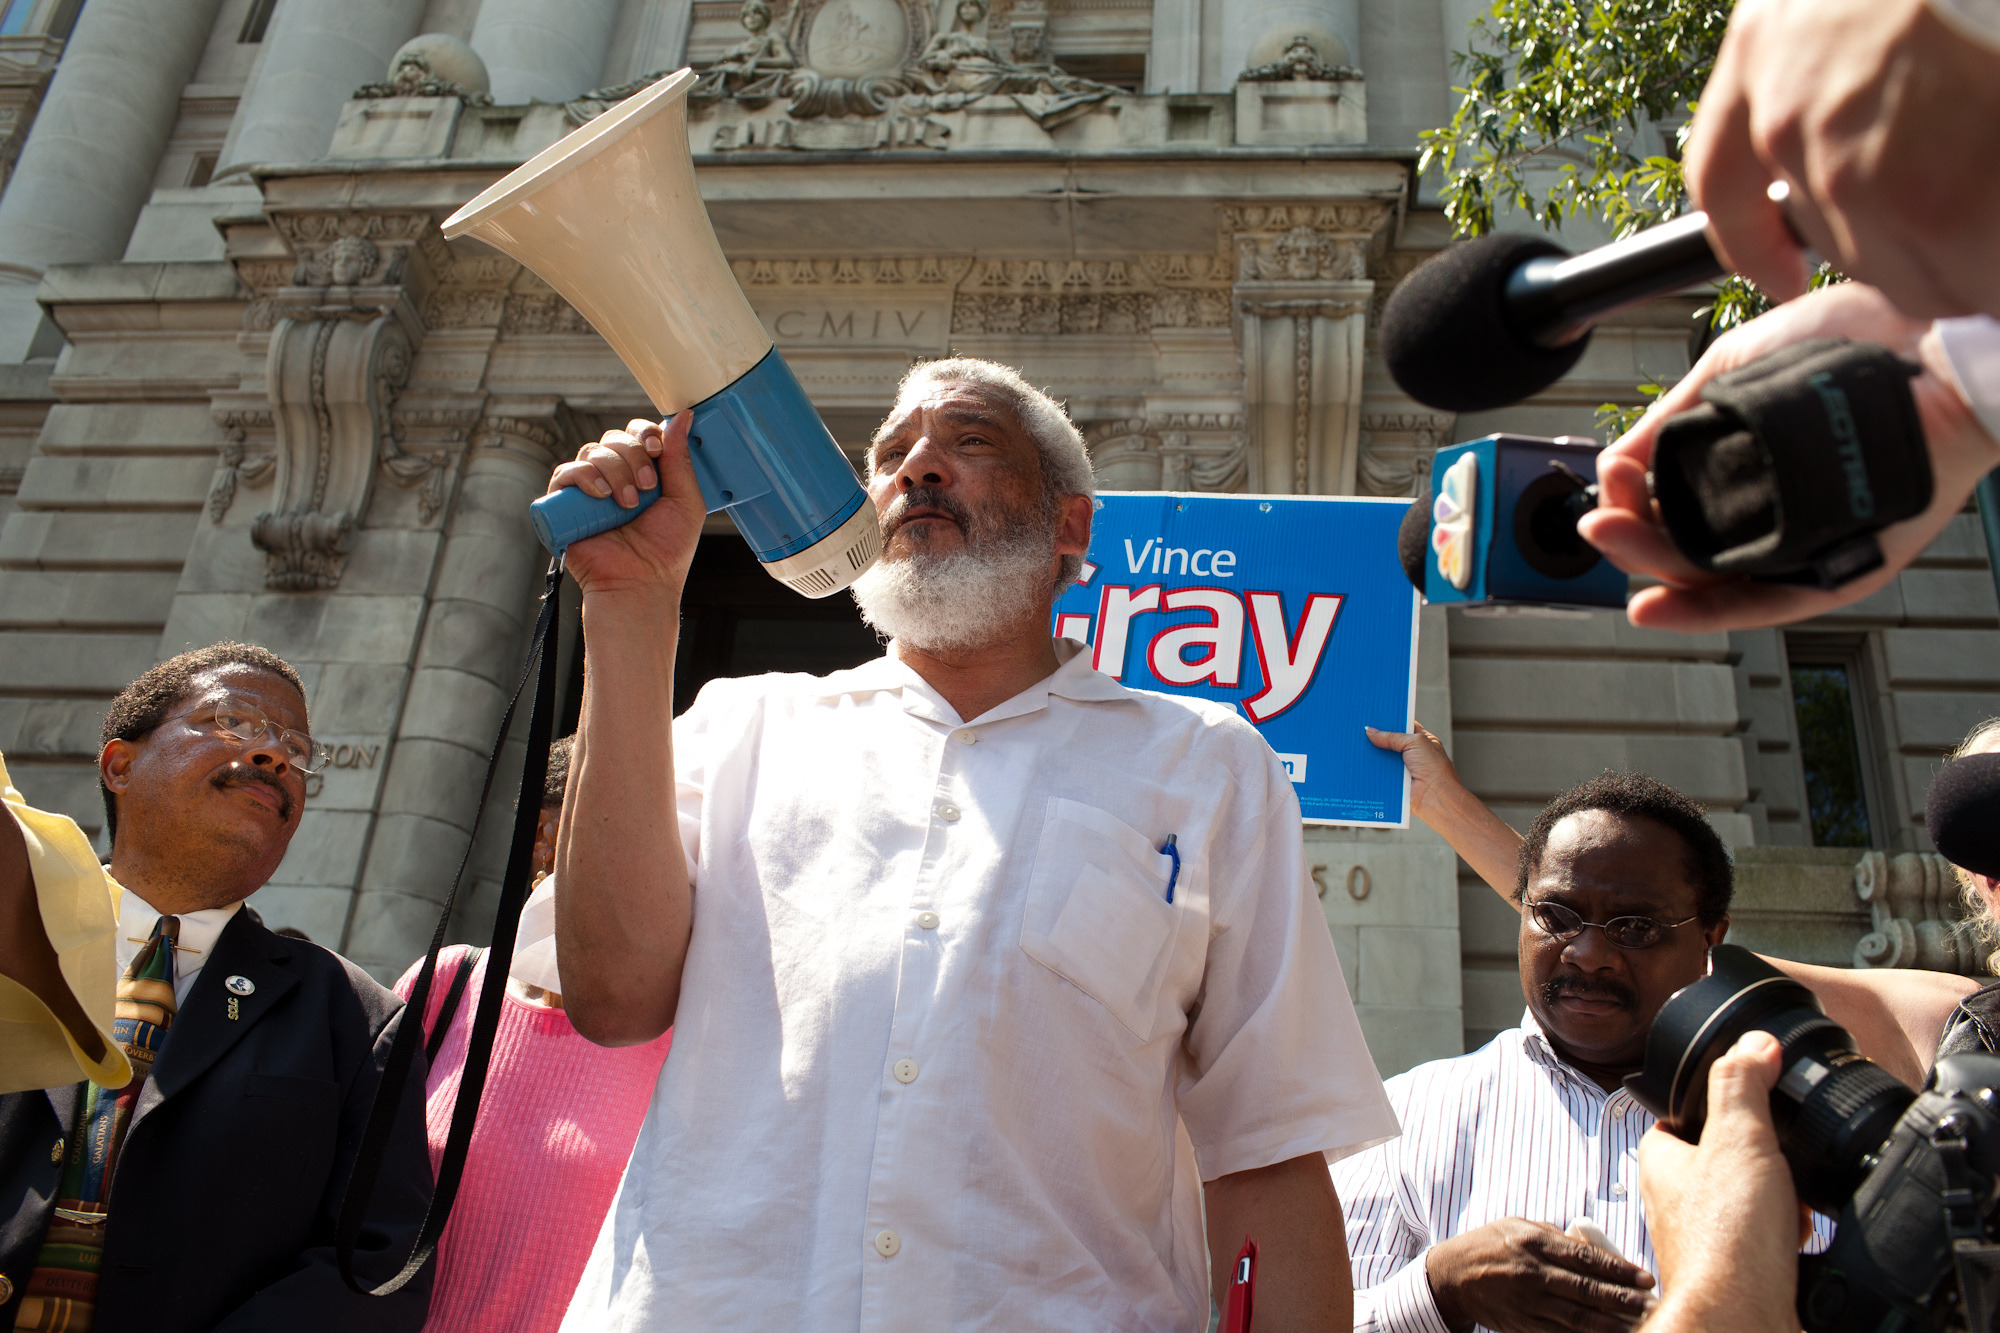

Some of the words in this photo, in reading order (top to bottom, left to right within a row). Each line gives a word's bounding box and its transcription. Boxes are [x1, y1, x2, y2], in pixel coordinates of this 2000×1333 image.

[754, 309, 926, 339] CMIV
[1124, 537, 1237, 577] Vince
[1053, 561, 1345, 725] ray
[1374, 811, 1384, 819] 18
[228, 997, 239, 1020] SCLC
[92, 1115, 109, 1165] GALATIANS
